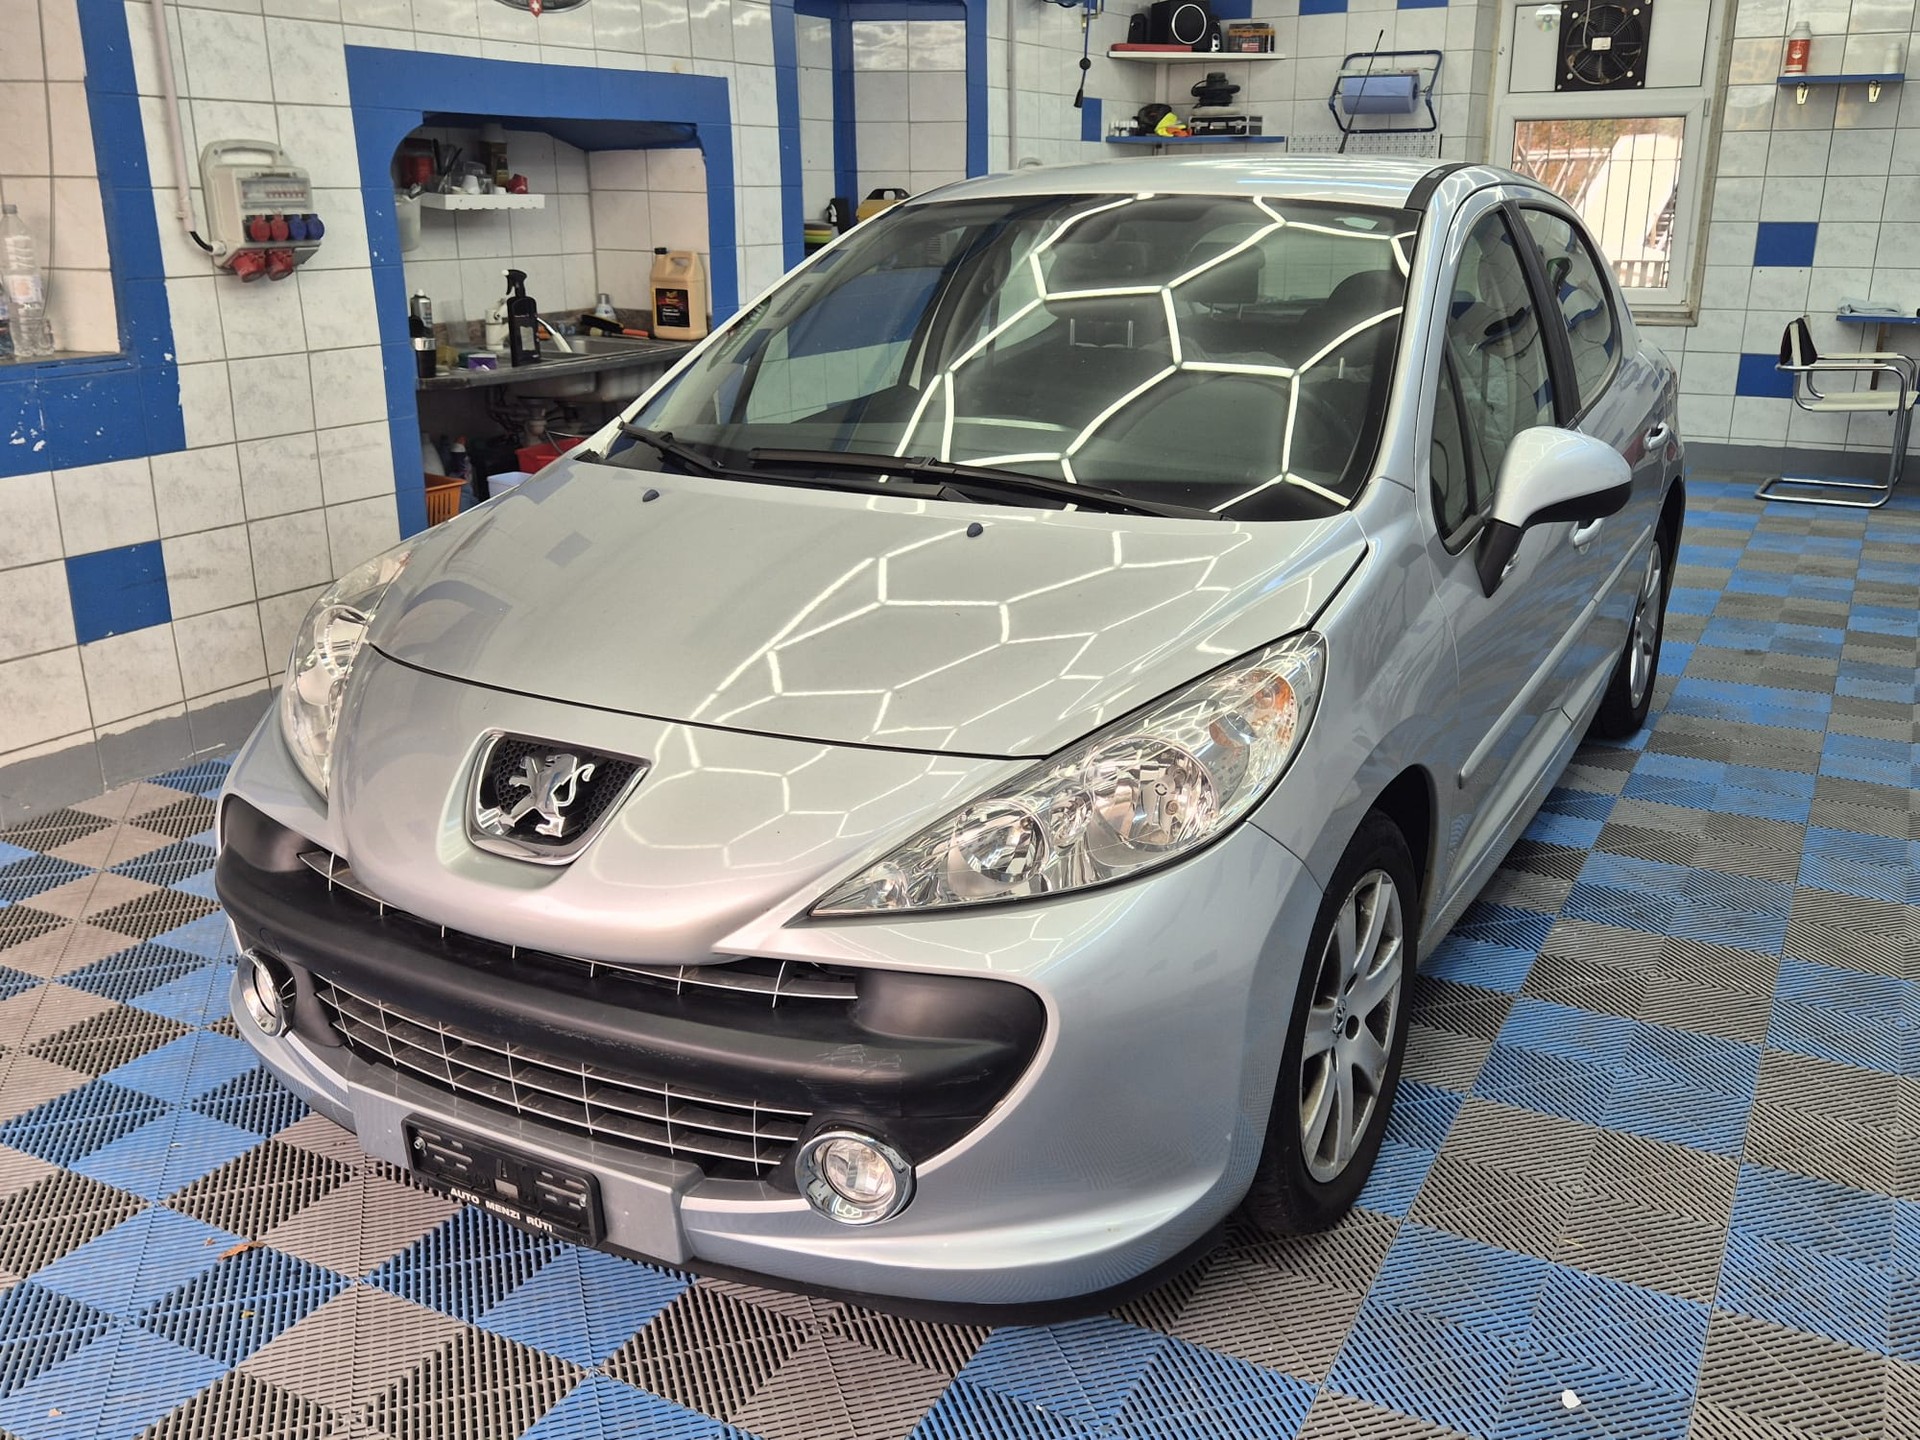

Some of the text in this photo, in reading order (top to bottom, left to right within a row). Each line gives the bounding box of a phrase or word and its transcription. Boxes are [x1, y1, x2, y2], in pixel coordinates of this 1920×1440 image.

[450, 1187, 553, 1232] AUTO MENZI RÜTI
